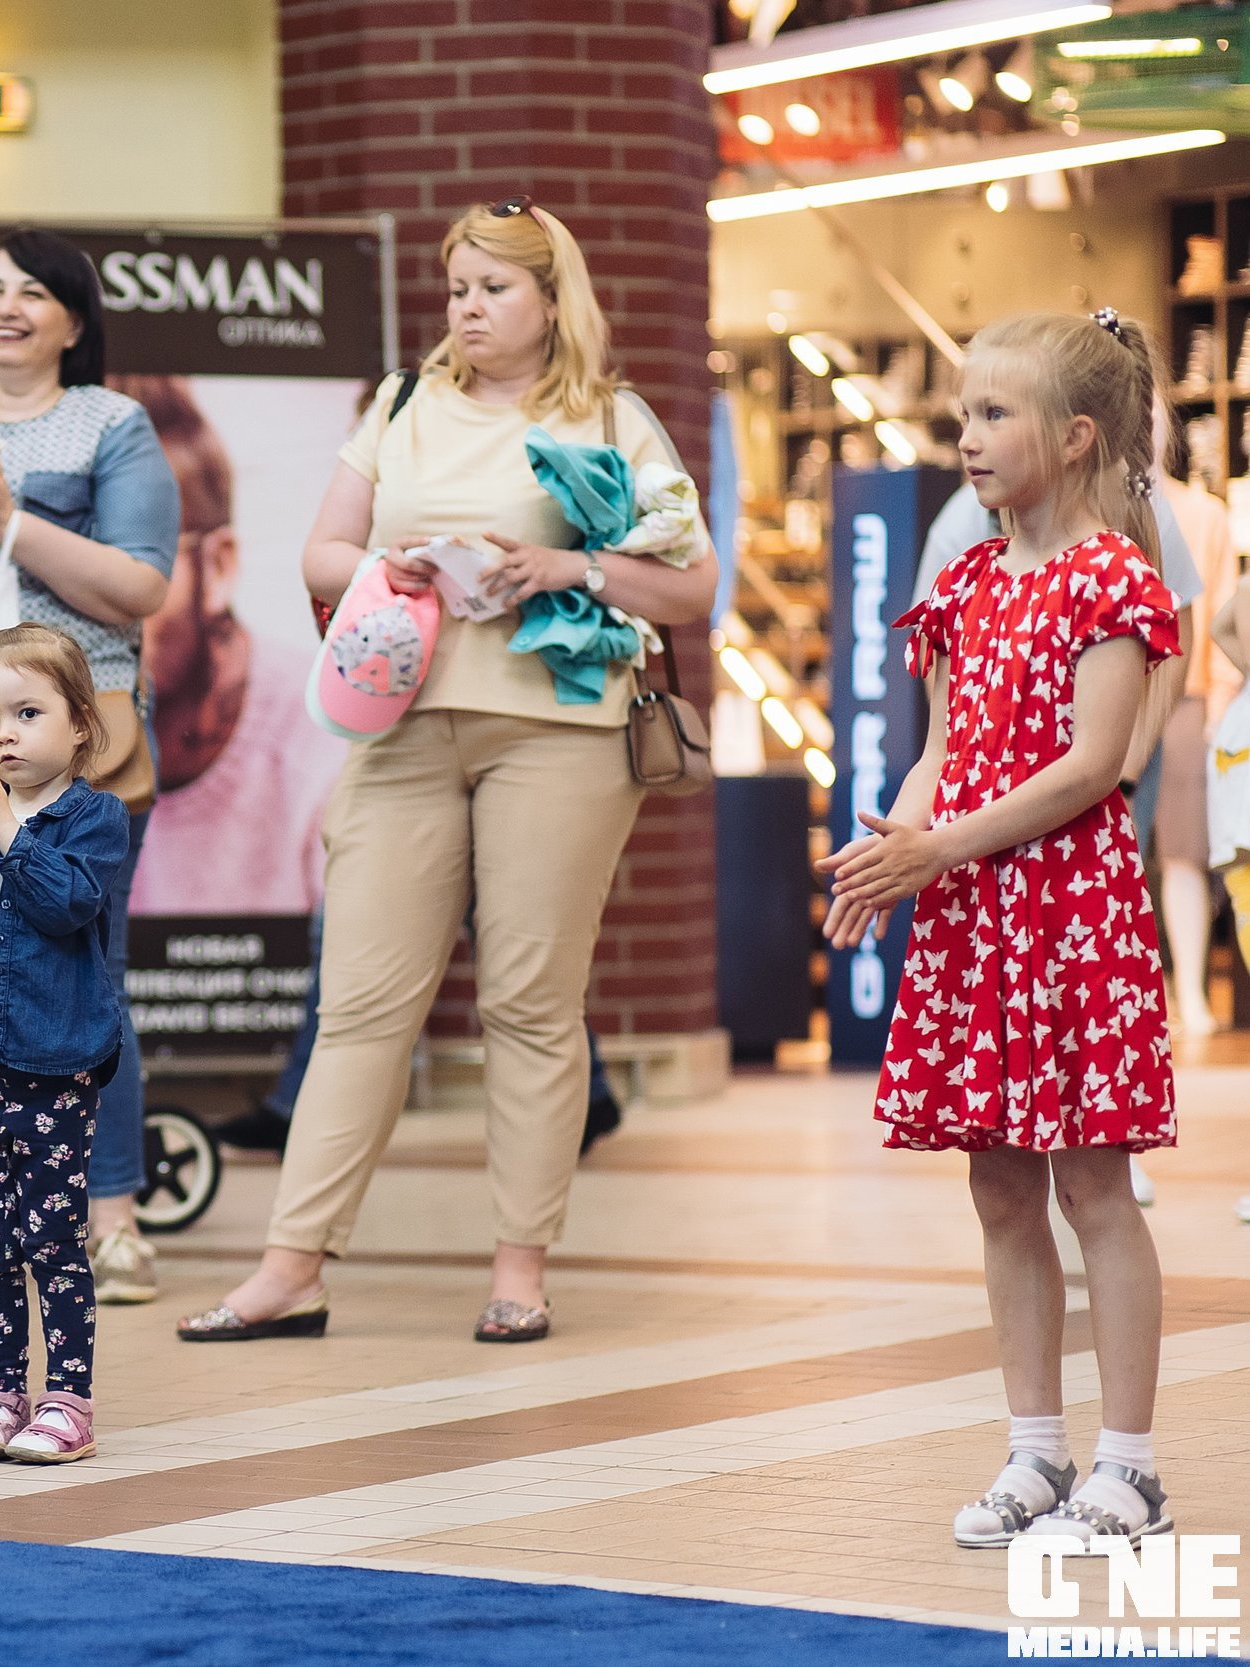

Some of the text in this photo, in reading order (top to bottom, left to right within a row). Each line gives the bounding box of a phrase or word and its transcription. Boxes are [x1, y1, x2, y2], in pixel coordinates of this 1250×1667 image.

[101, 250, 324, 316] SSMAN
[166, 934, 262, 966] НОВАЯ
[124, 968, 245, 998] ЛЛЕКЦИЯ
